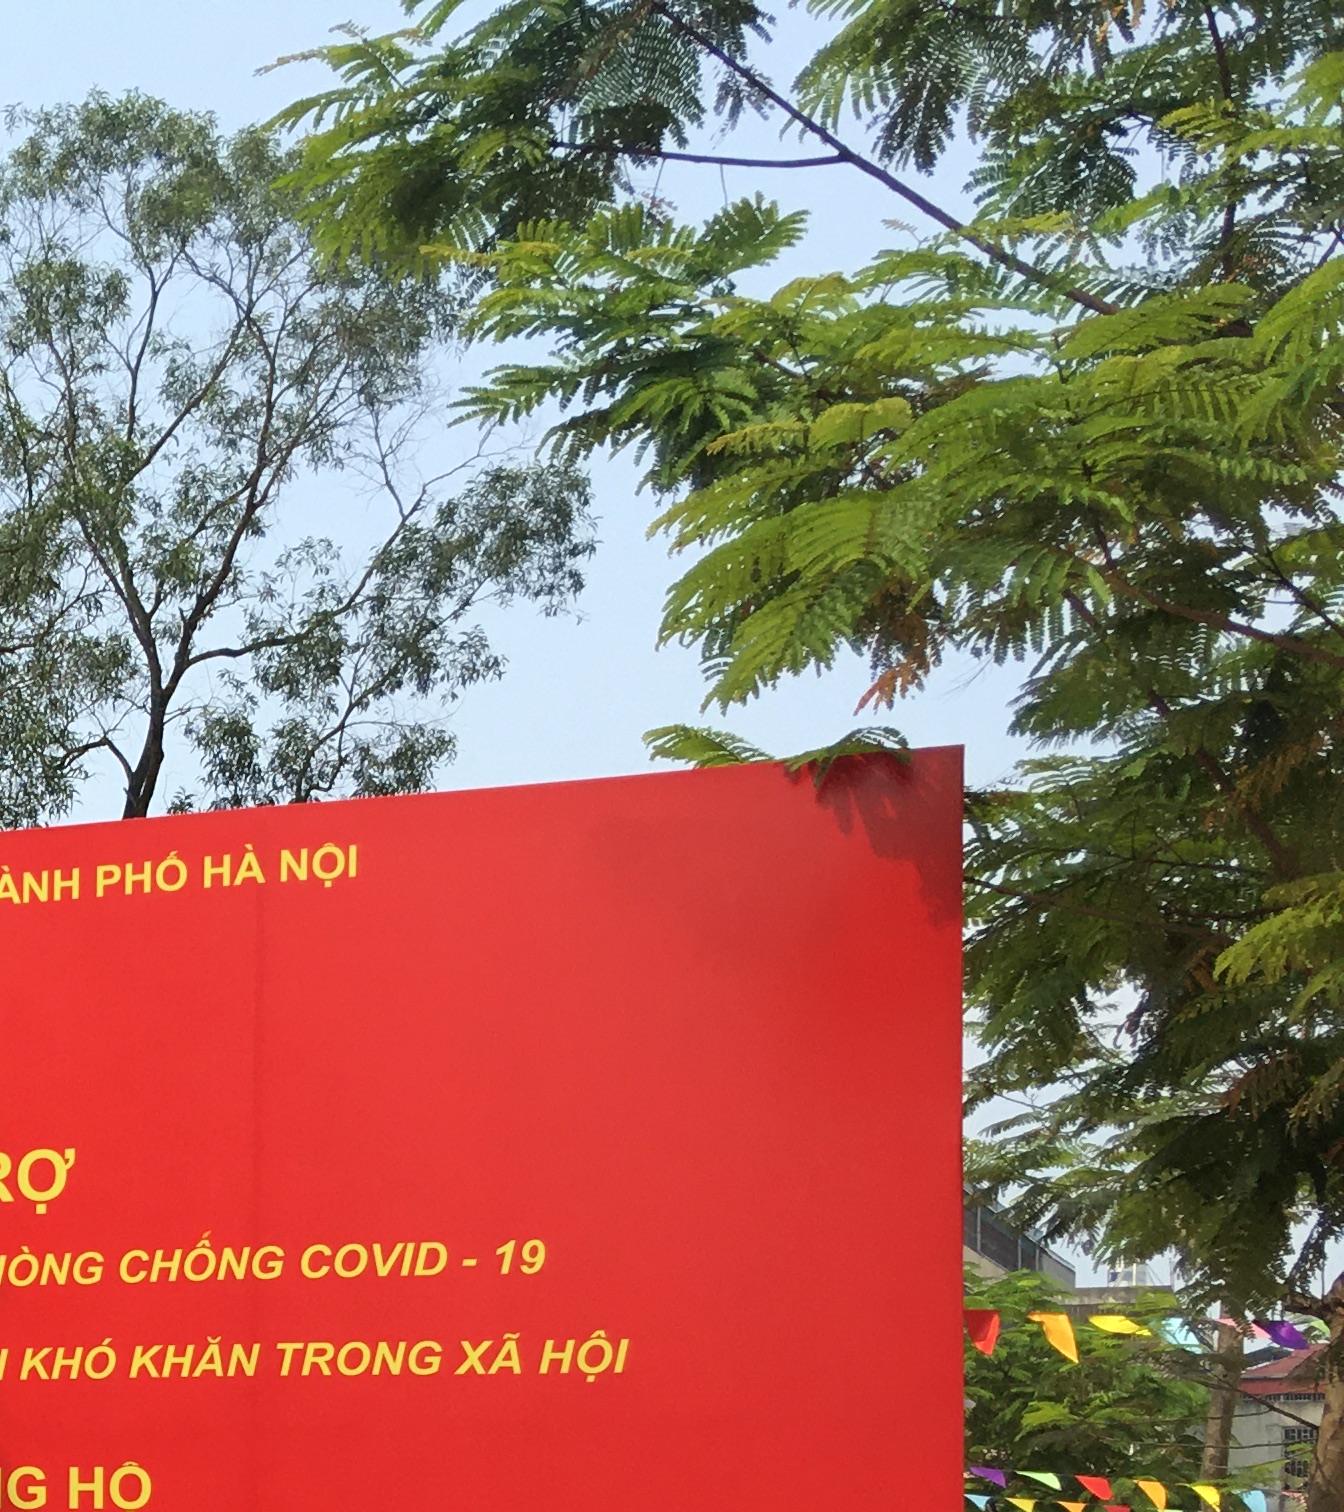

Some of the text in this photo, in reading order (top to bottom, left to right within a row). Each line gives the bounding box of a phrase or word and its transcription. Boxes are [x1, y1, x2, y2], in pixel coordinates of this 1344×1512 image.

[94, 849, 189, 899] PHỐ
[202, 842, 267, 890] HÀ
[279, 841, 359, 889] NỘI
[118, 1231, 286, 1285] CHỐNG
[299, 1240, 449, 1280] COVID
[494, 1238, 547, 1276] 19
[18, 1336, 118, 1382] KHÓ
[127, 1335, 262, 1380] KHĂN
[275, 1339, 444, 1378] TRONG
[453, 1331, 523, 1376] XÃ
[537, 1328, 631, 1384] HỘI
